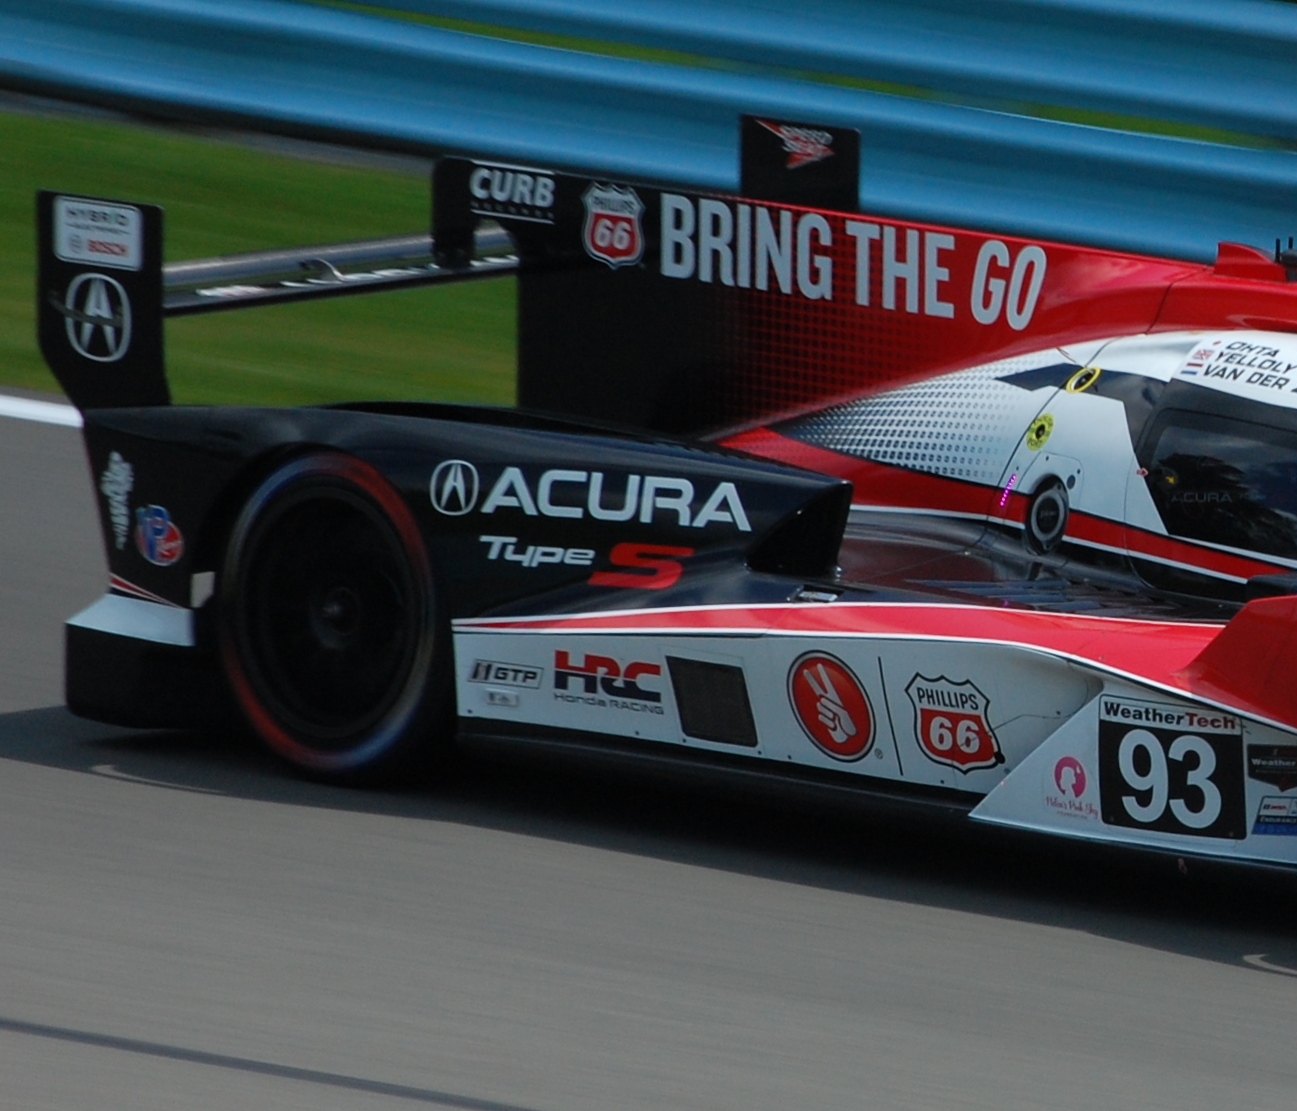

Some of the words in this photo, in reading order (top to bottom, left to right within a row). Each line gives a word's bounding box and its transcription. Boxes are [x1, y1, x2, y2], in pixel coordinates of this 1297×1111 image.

[469, 167, 556, 208] CURB
[593, 218, 631, 250] 66
[660, 192, 833, 301] BRING
[845, 219, 955, 318] THE
[971, 240, 1047, 331] GO
[1225, 341, 1280, 358] OHTA
[1203, 364, 1245, 381] VAN
[1245, 371, 1290, 390] DER
[480, 466, 752, 532] ACURA
[479, 535, 596, 568] Type
[587, 542, 694, 590] S
[494, 666, 538, 682] GTP
[554, 650, 661, 703] HRC
[554, 692, 607, 707] Honda
[608, 699, 665, 715] RACING
[916, 686, 979, 711] PHILLIPS
[1104, 701, 1236, 730] WeatherTech
[930, 716, 980, 754] 66
[1118, 728, 1222, 829] 93
